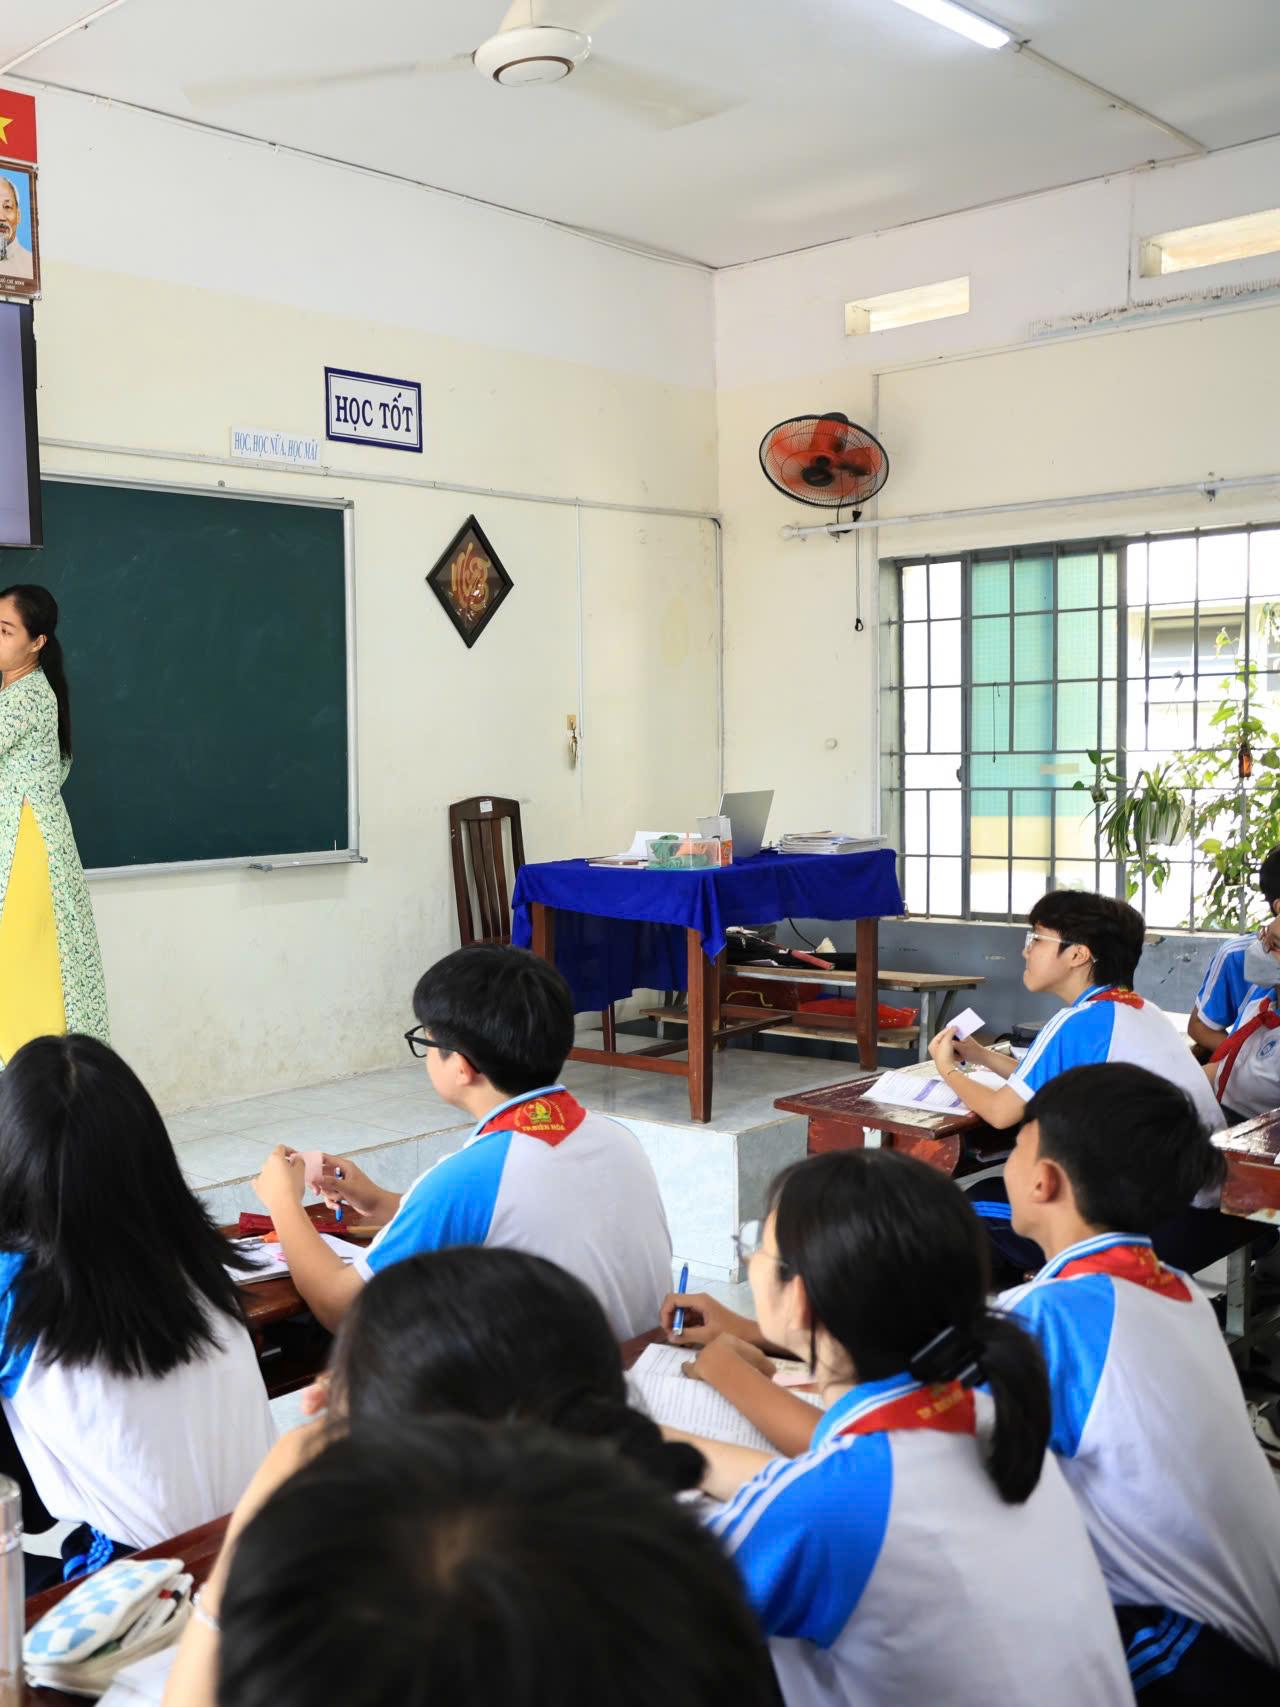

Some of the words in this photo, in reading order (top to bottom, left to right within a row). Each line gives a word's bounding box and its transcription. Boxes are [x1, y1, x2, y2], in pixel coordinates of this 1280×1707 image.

[334, 395, 374, 432] HỌC
[378, 391, 414, 433] TỐT
[253, 434, 268, 458] HỌC
